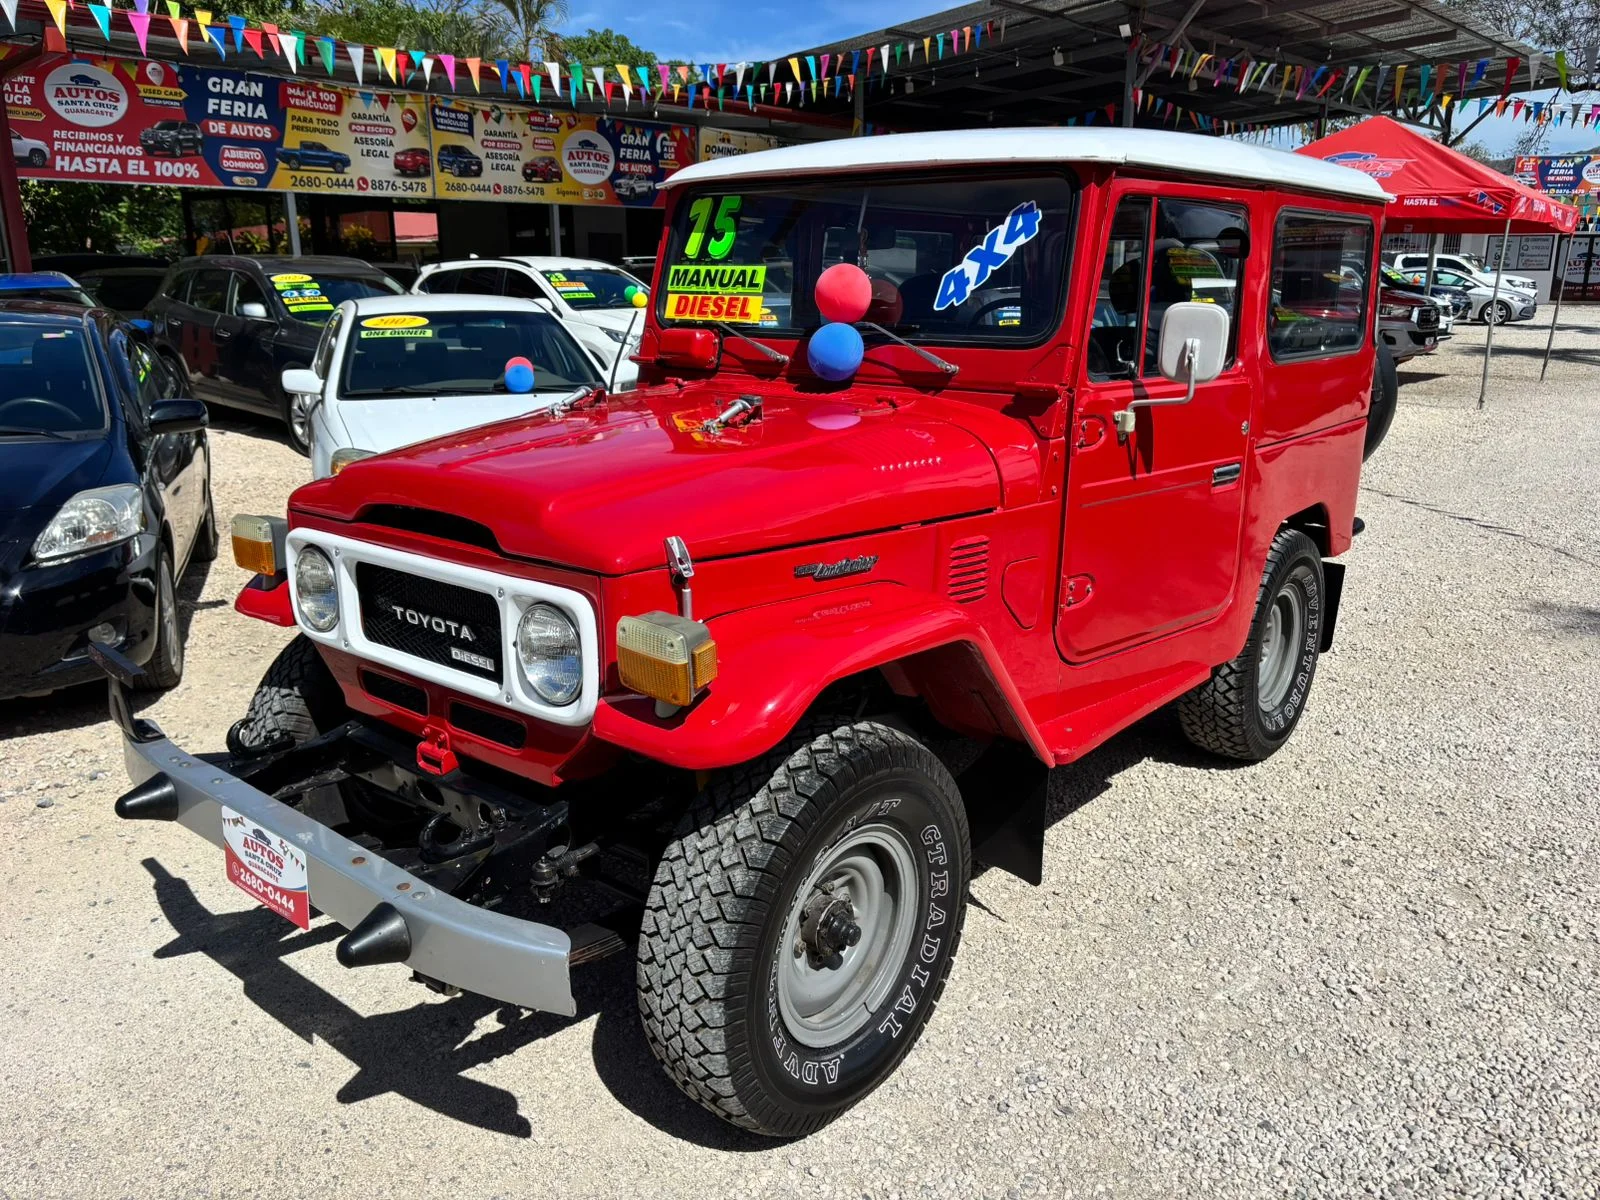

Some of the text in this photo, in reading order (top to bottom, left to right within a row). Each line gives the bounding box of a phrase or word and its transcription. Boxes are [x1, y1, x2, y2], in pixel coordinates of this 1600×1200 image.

[3, 83, 30, 95] A LA
[143, 88, 183, 98] USED CARS
[207, 77, 263, 98] GRAN
[5, 94, 32, 105] UCR
[54, 87, 120, 103] AUTOS
[319, 92, 336, 102] 100
[57, 100, 119, 111] SANTA CRUZ
[207, 99, 268, 120] FERIA
[64, 108, 114, 118] GUANACASTE
[351, 112, 391, 123] GARANTÍA
[291, 115, 339, 128] PARA TODO
[209, 121, 272, 138] DE AUTOS
[291, 125, 340, 137] PRESUPUESTO
[366, 126, 394, 134] ESCRITO
[484, 130, 518, 139] GARANTÍA
[53, 130, 124, 142] RECIBIMOS Y
[353, 136, 395, 148] ASESORÍA
[620, 134, 650, 147] GRAN
[54, 142, 143, 156] FINANCIAMOS
[483, 140, 520, 150] POR ESCRITO
[224, 149, 261, 160] ABIERTO
[360, 149, 390, 158] LEGAL
[485, 151, 520, 162] ASESORÍA
[568, 151, 610, 163] AUTOS
[620, 148, 651, 160] FERIA
[55, 156, 199, 178] HASTA EL 100%
[222, 160, 265, 170] DOMINGOS
[491, 163, 516, 172] LEGAL
[620, 163, 629, 172] DE
[630, 164, 652, 174] AUTOS
[290, 175, 427, 193] 2680-0444 8876-5478
[445, 182, 545, 196] 2680-0444 8876-5478
[670, 268, 761, 288] MANUAL
[674, 295, 751, 319] DIESEL
[372, 318, 417, 326] 2007
[392, 605, 476, 642] TOYOTA
[452, 650, 494, 671] DIESEL
[242, 836, 284, 870] AUTOS
[245, 850, 282, 878] SANTA CRUZ
[240, 868, 294, 912] 2680-0444
[879, 825, 949, 1038] GTRADIAL
